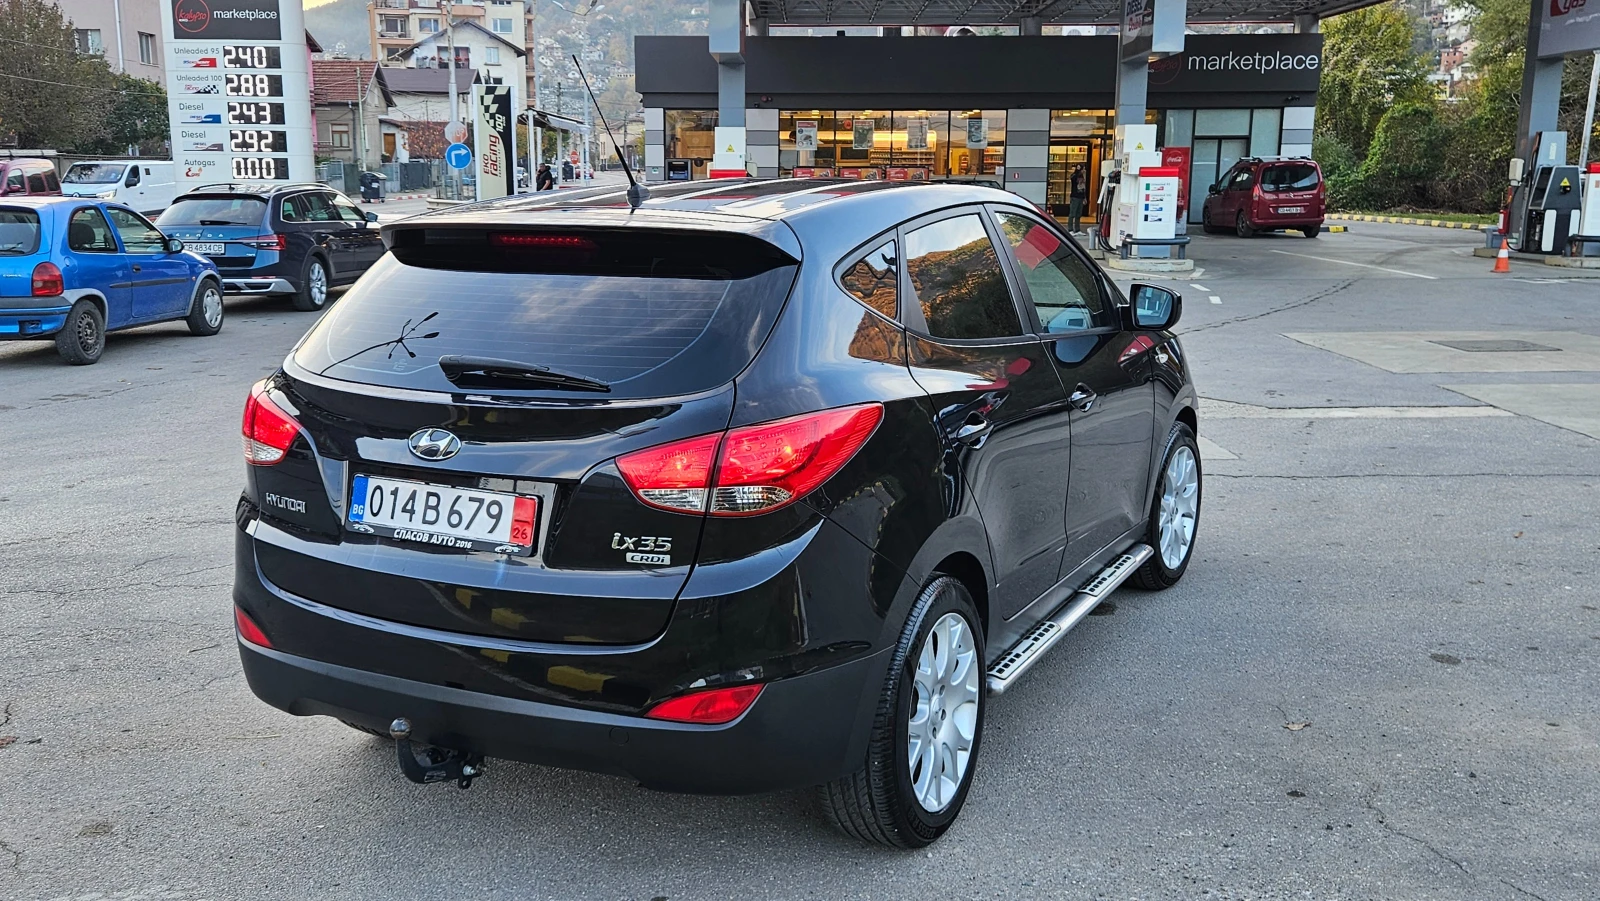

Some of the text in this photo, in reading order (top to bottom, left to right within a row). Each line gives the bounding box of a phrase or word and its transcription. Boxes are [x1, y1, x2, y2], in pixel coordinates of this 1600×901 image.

[213, 8, 278, 21] marketplace
[174, 47, 209, 55] Unleaded
[224, 45, 267, 68] 2.40
[1188, 50, 1319, 74] marketplace
[176, 74, 222, 82] Unleaded 100
[226, 74, 270, 96] 2.88
[178, 102, 204, 111] Diesel
[228, 102, 271, 124] 2.43
[495, 113, 504, 132] 100
[181, 130, 206, 139] Diesel
[230, 130, 273, 152] 2.92
[184, 159, 216, 167] Autogas
[482, 153, 490, 174] EKO
[489, 134, 500, 177] racing
[232, 157, 276, 179] 0.00
[212, 244, 223, 252] CB
[265, 492, 306, 514] HYUNDAI
[352, 484, 529, 540] BG 014B679 26
[393, 528, 473, 549] СПАСОВ АУТО 2016
[611, 532, 673, 552] ix35
[630, 554, 666, 563] CRDi
